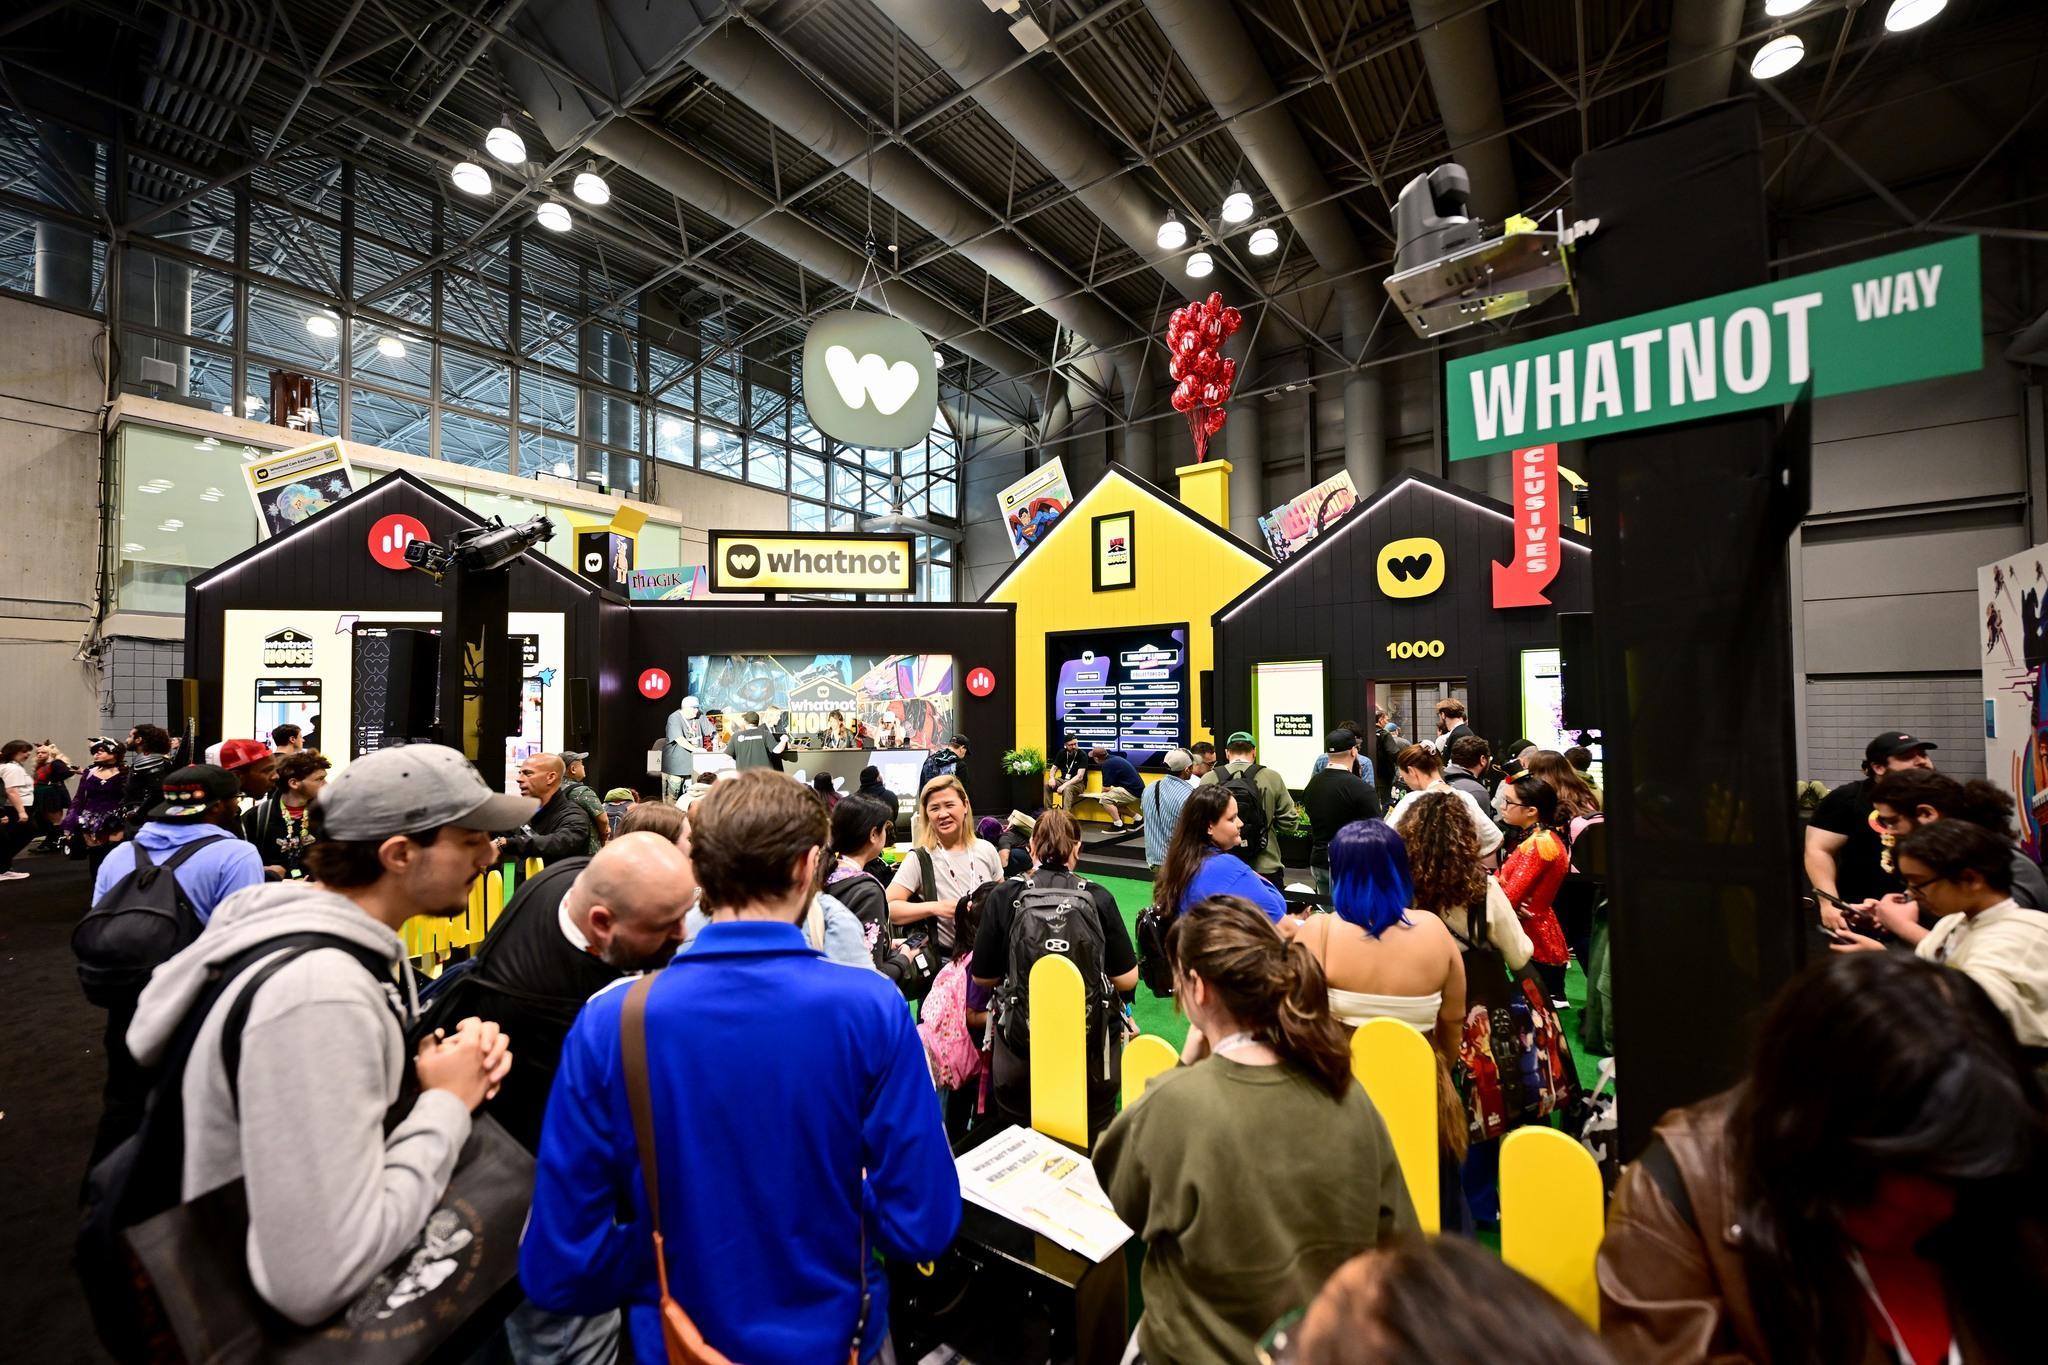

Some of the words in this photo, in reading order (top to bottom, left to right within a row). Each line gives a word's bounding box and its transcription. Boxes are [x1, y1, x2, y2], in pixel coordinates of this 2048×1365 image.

[1469, 292, 1823, 442] WHATNOT
[1851, 264, 1943, 322] WAY
[767, 549, 900, 574] whatnot
[264, 649, 313, 664] HOUSE
[1386, 640, 1445, 660] 1000
[790, 699, 856, 712] whatnot
[1275, 722, 1284, 730] of
